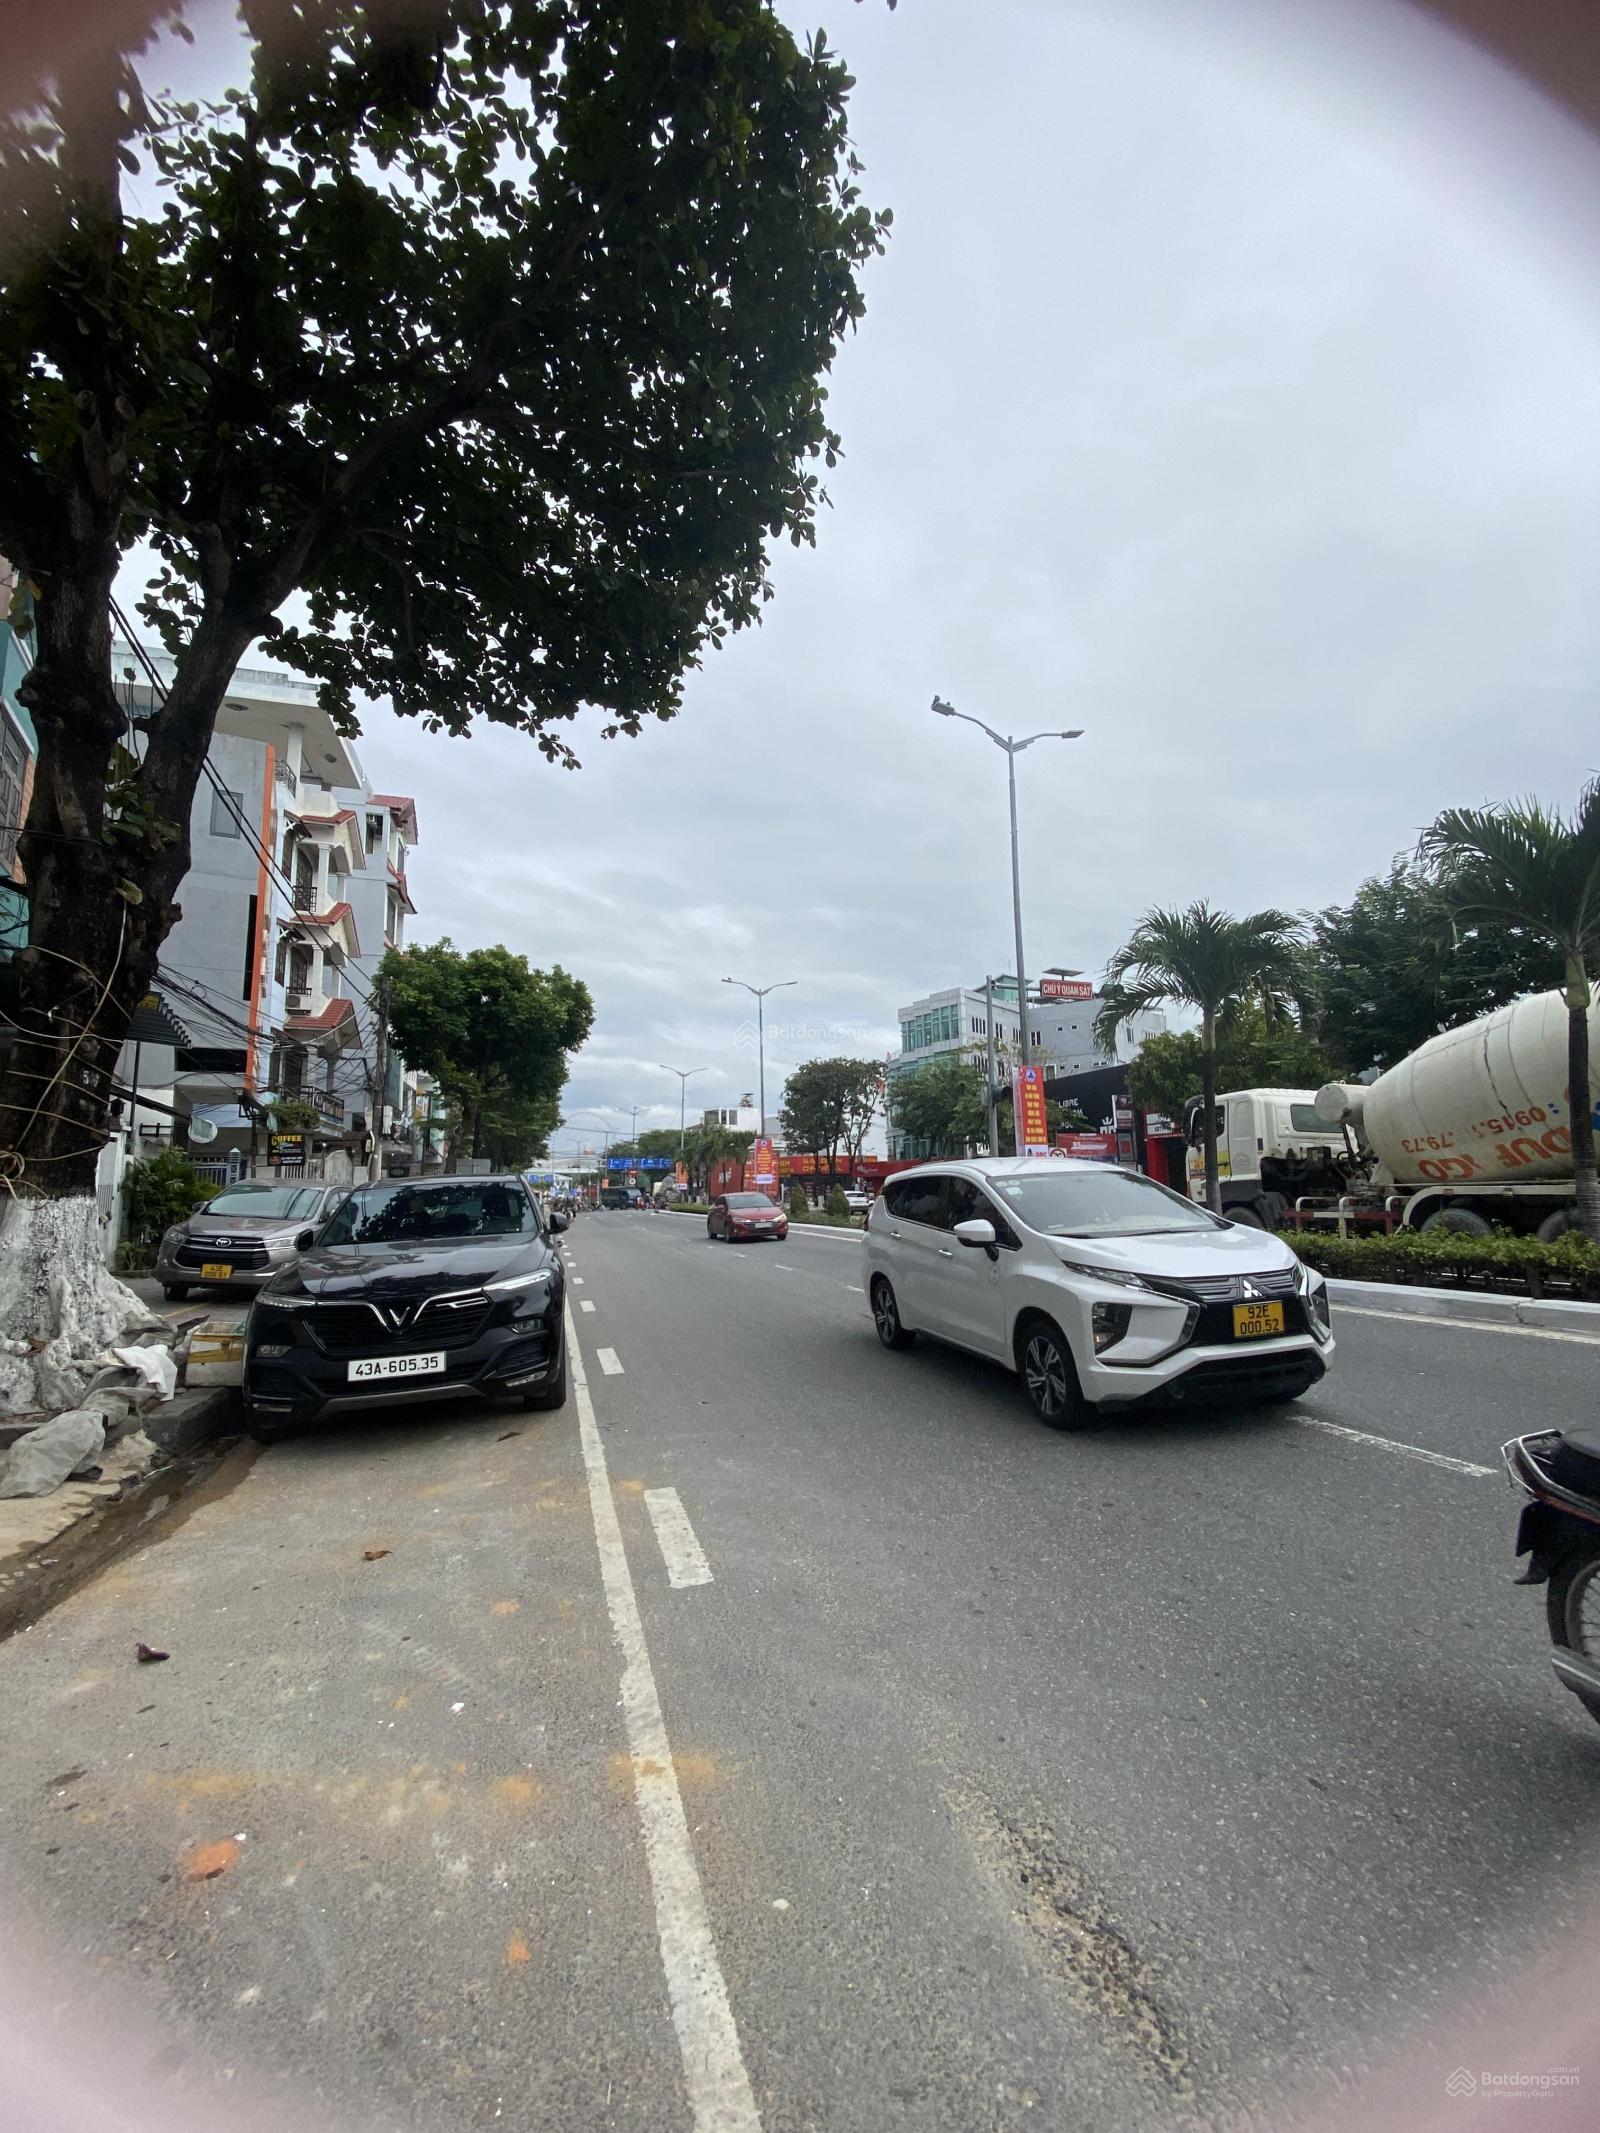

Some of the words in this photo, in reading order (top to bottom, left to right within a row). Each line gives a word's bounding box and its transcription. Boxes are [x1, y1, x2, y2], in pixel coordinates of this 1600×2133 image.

[1061, 984, 1079, 996] QUAN
[1079, 984, 1090, 996] SÁT
[271, 1135, 302, 1146] COFFEE
[1248, 1305, 1269, 1319] 92E
[1240, 1318, 1279, 1334] 000.52
[355, 1356, 438, 1376] 43A-605.35
